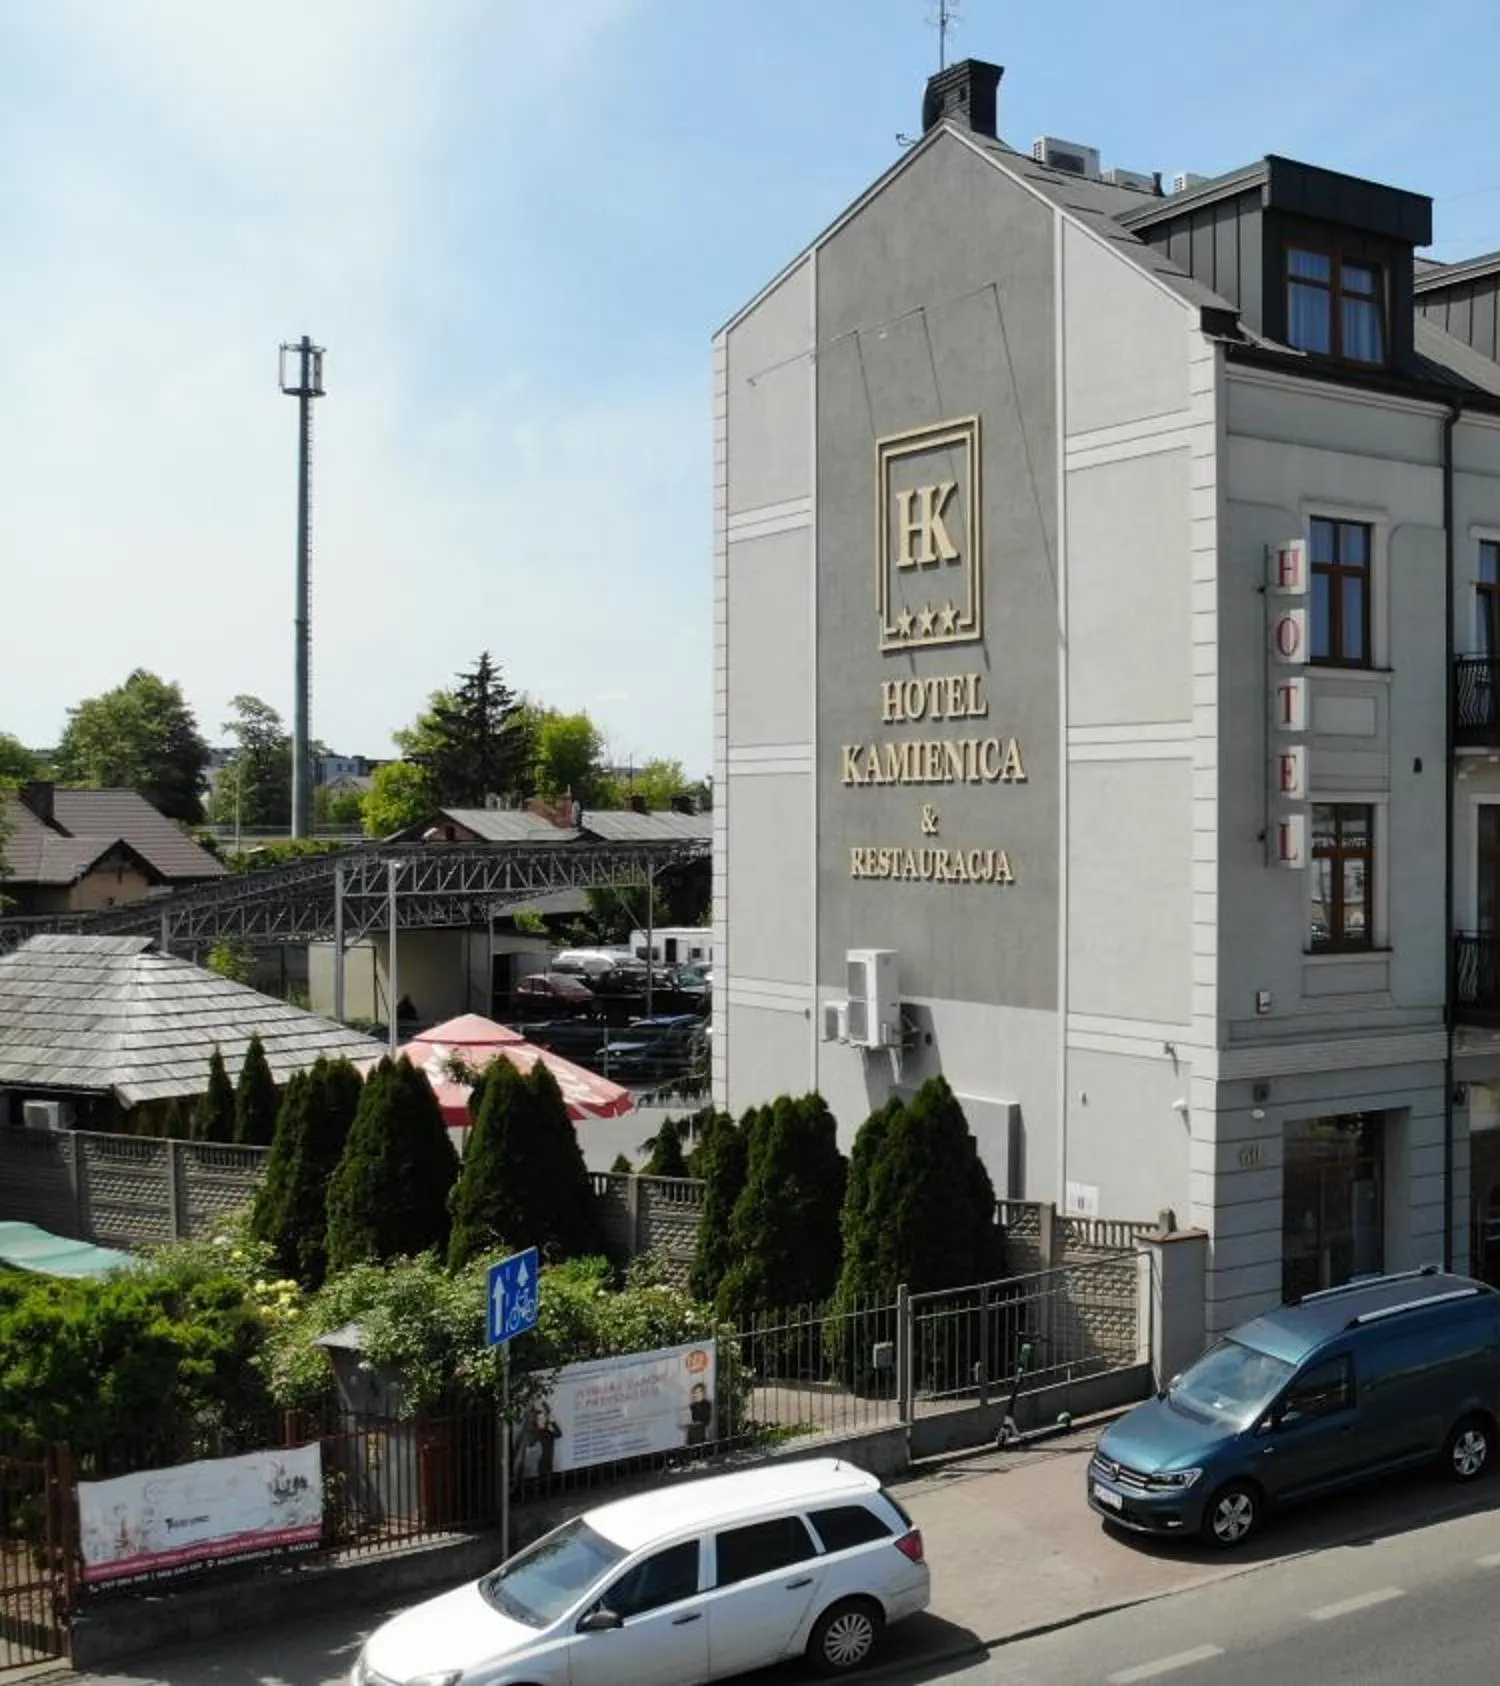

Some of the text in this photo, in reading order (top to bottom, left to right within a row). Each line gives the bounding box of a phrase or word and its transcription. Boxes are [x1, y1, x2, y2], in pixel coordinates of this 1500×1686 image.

[896, 480, 961, 568] HK
[881, 673, 988, 722] HOTEL
[1277, 548, 1300, 861] HOTEL
[841, 738, 1027, 785] KAMIENICA
[921, 804, 939, 835] &
[850, 847, 1015, 884] RESTAURACJA
